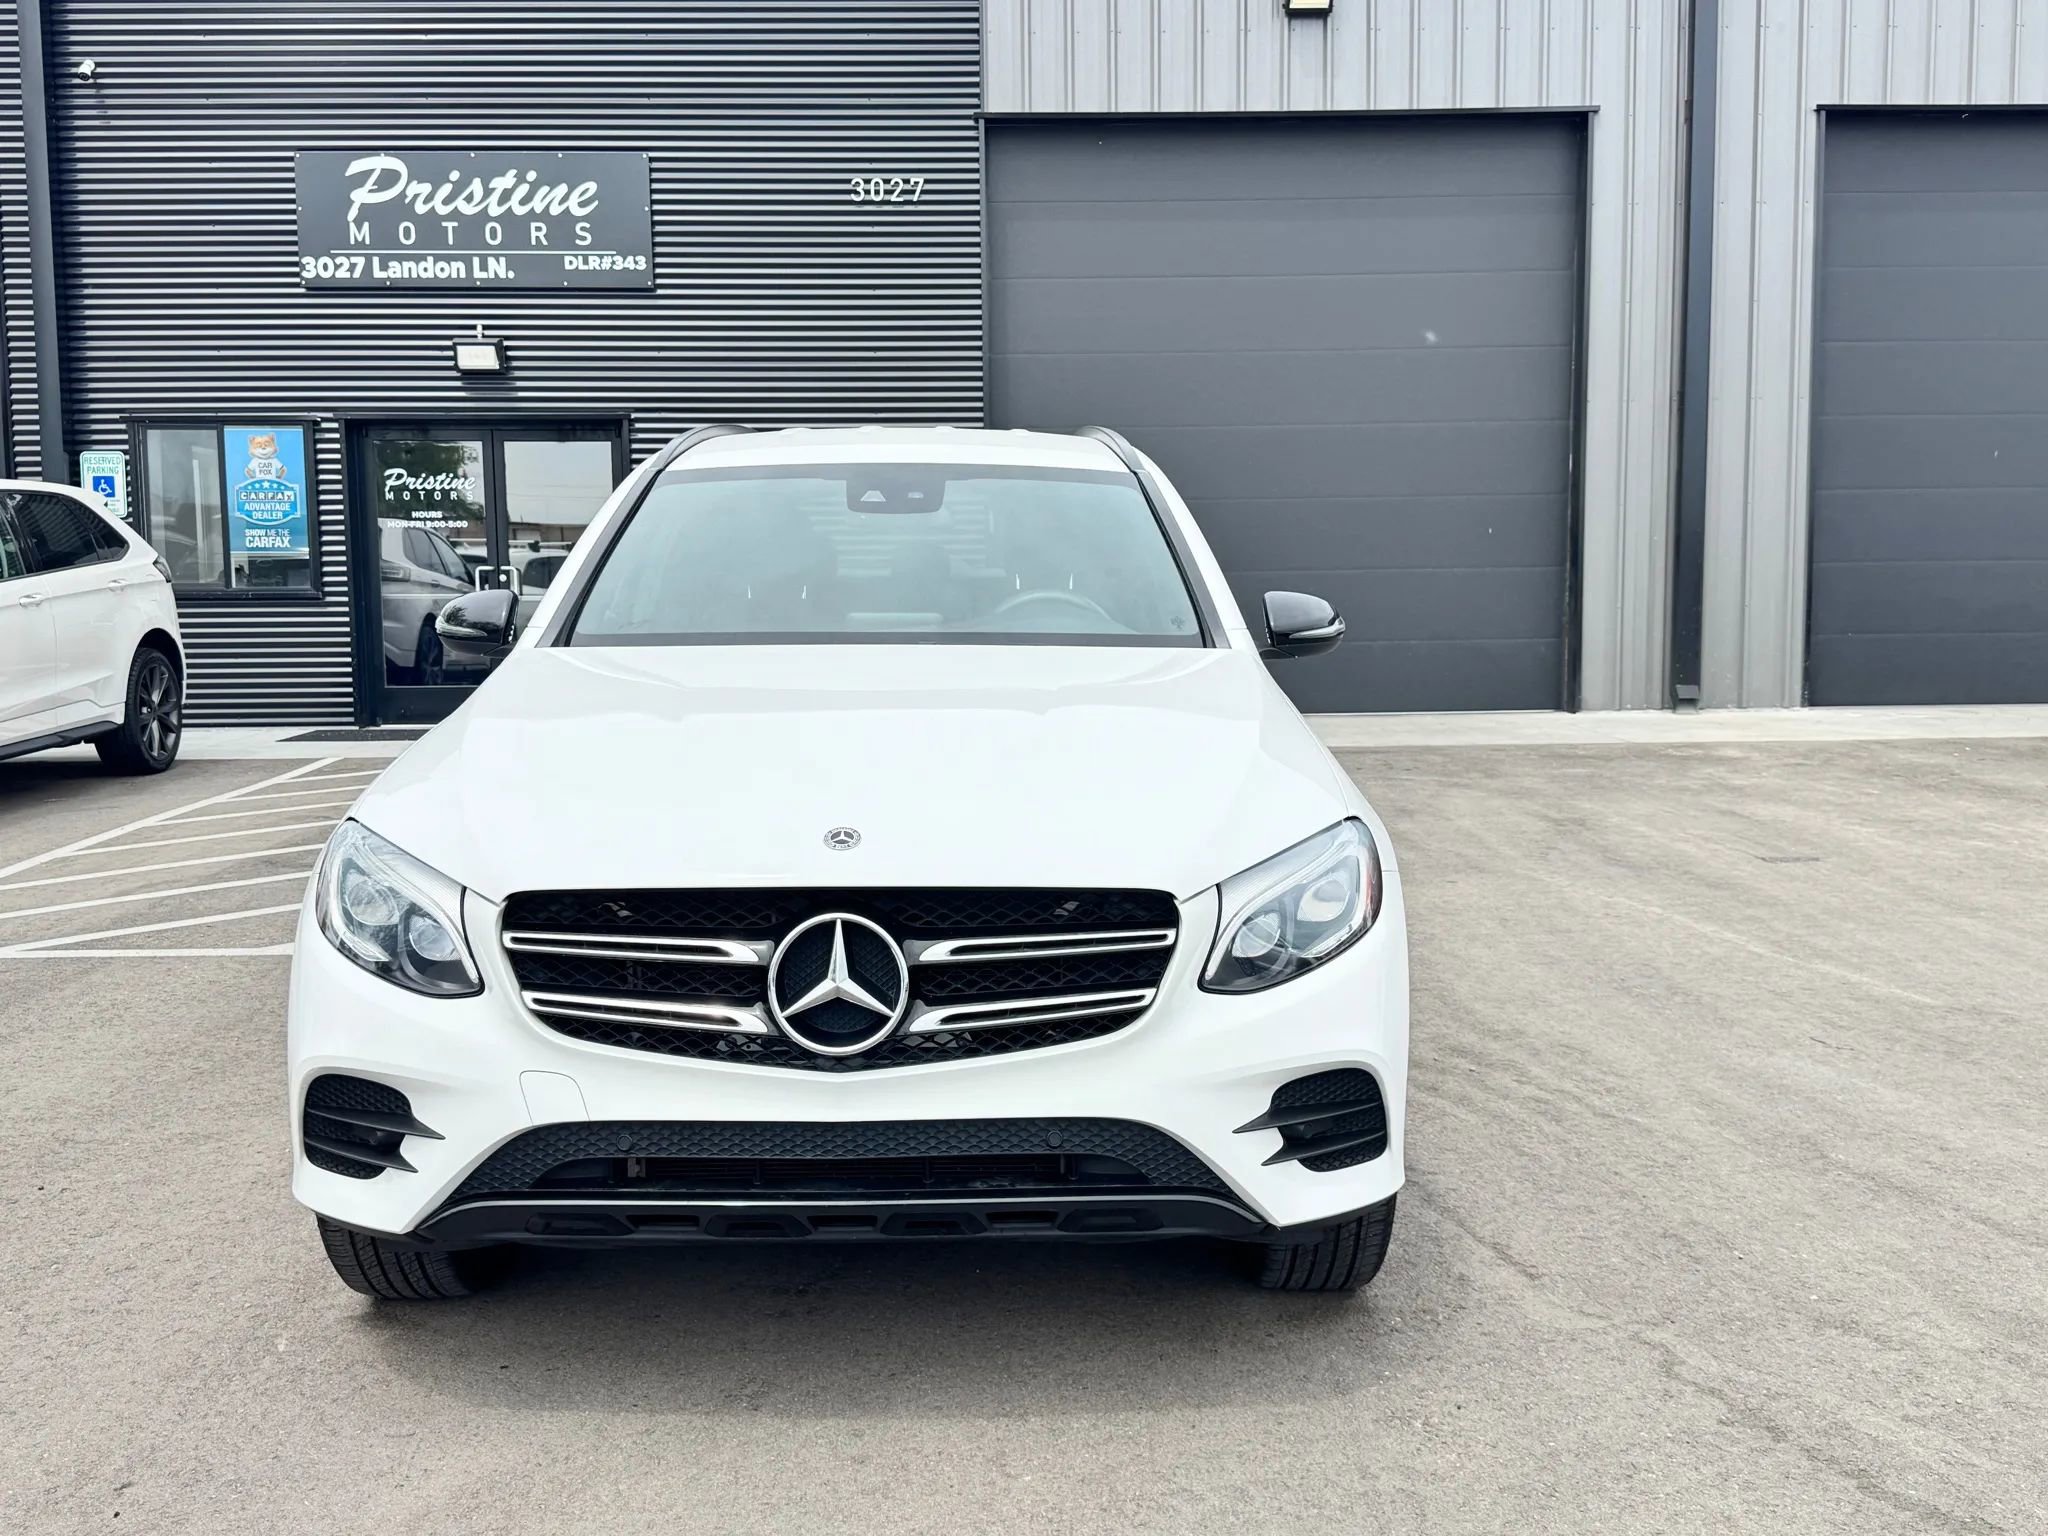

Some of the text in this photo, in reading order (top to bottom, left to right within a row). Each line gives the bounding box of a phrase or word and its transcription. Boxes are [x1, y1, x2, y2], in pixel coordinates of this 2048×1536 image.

[344, 156, 600, 222] Pristine
[850, 177, 925, 202] 3027
[350, 221, 593, 246] MOTORS
[301, 256, 515, 280] 3027 Landon LN.
[564, 255, 647, 271] DLR#343
[84, 457, 121, 465] RESERVED
[87, 466, 119, 474] PARKING
[384, 468, 476, 491] Pristine
[240, 491, 294, 501] CARFAX
[385, 491, 474, 501] MOTORS
[244, 502, 291, 511] ADVANTAGE
[252, 511, 283, 520] DEALER
[411, 511, 443, 519] HOURS
[245, 529, 290, 537] SHOW ME THE
[245, 537, 292, 548] CARFAX
